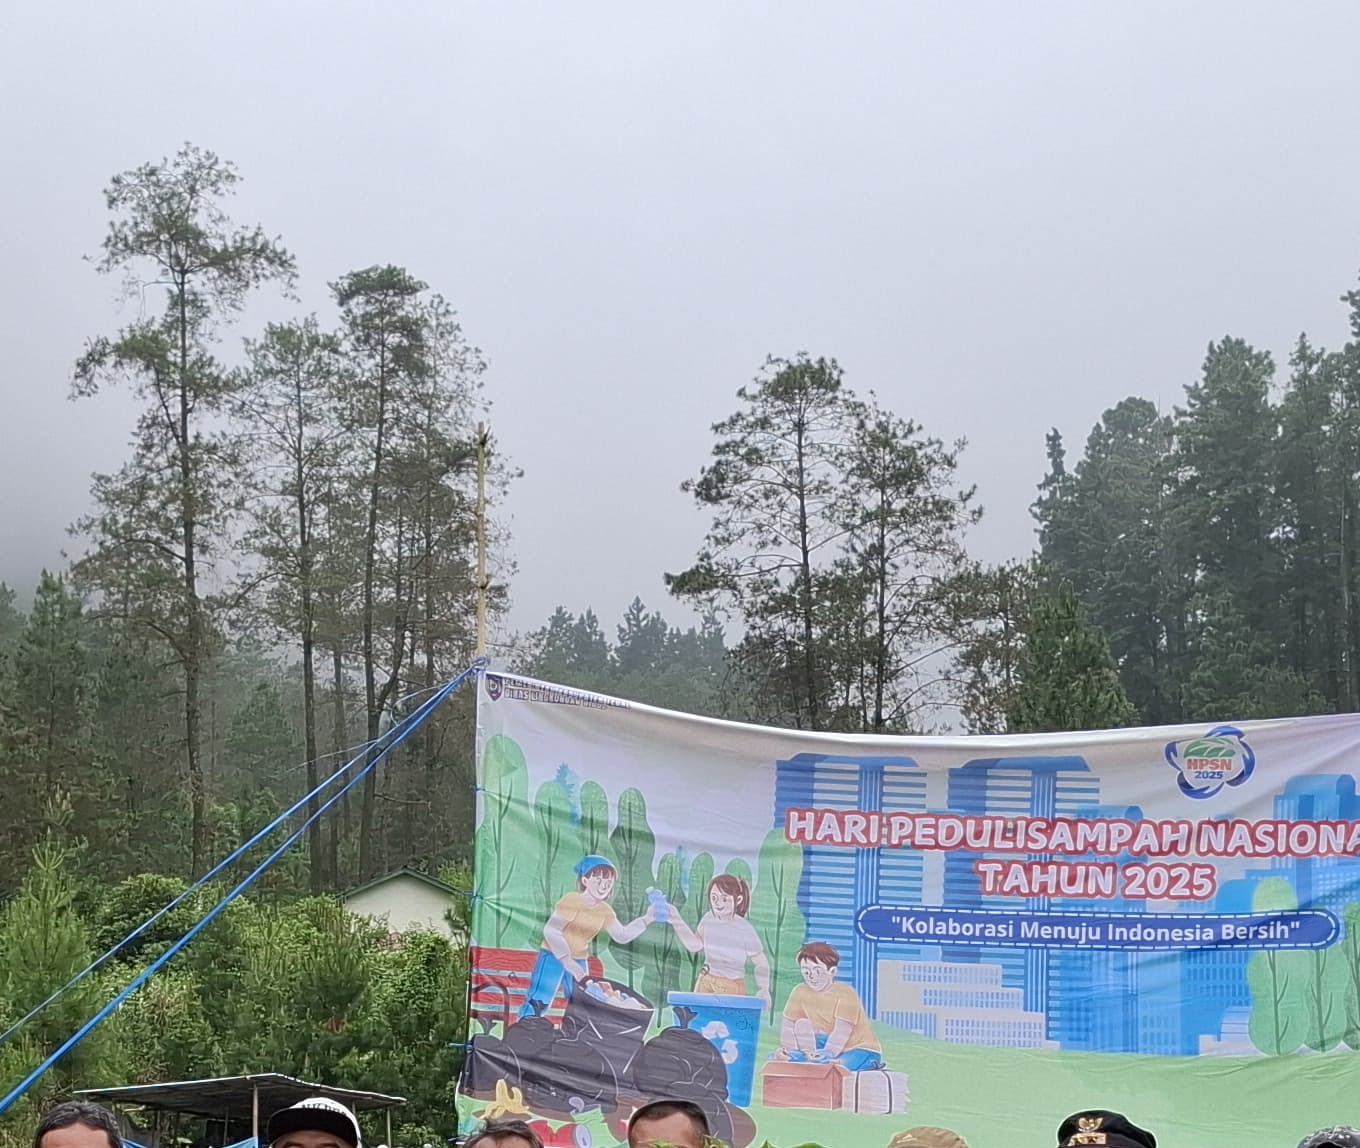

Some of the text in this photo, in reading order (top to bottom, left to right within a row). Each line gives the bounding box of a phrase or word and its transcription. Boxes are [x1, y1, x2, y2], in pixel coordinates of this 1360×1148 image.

[1186, 757, 1233, 771] HPSN
[1194, 770, 1224, 780] 2025
[787, 810, 881, 846] HARI
[976, 861, 1215, 898] TAHUN 2025
[891, 914, 1301, 945] "Kolaborasi Menuju Indonesia Bersih"
